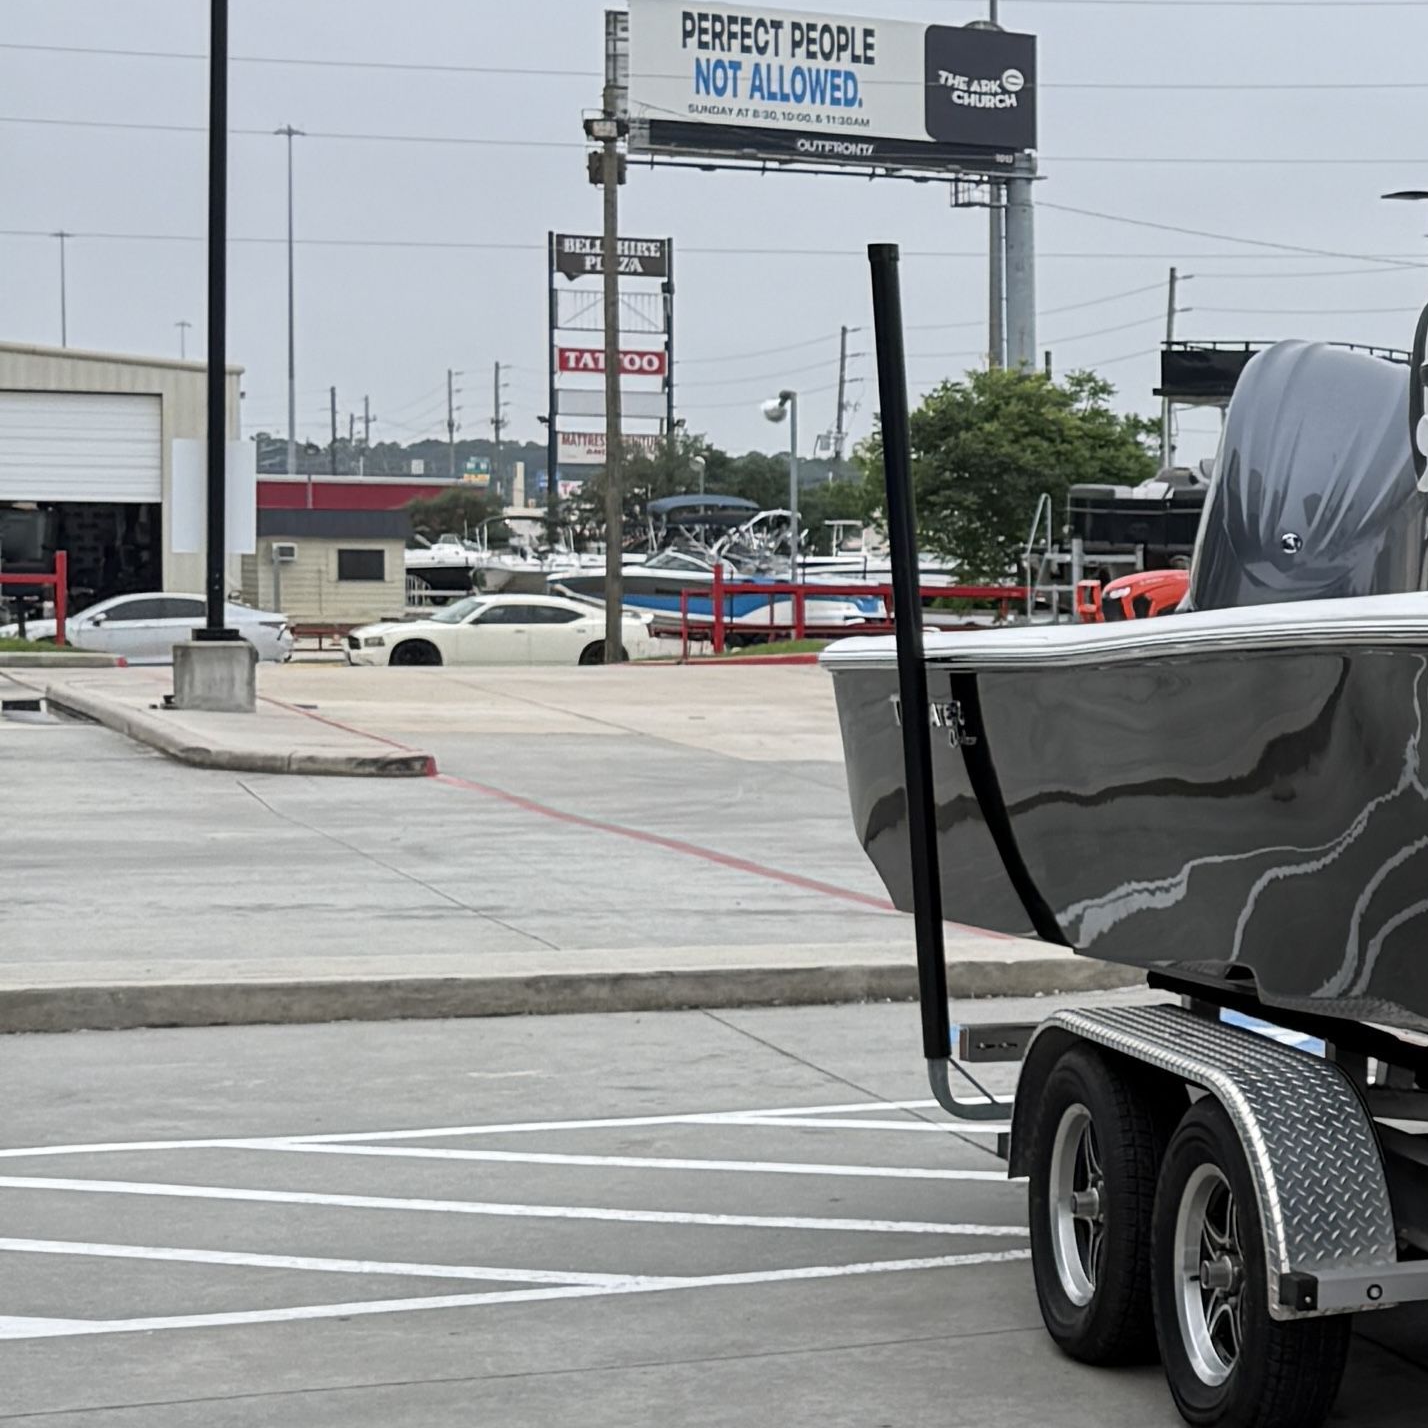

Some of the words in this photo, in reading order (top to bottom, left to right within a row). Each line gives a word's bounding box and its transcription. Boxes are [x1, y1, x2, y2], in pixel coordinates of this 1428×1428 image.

[682, 11, 784, 57] PERFECT
[791, 21, 876, 65] PEOPLE
[695, 57, 742, 98] NOT
[749, 62, 863, 108] ALLOWED.
[938, 70, 969, 90] THE
[970, 79, 1002, 93] ARK
[952, 90, 1018, 108] CHURCH
[688, 103, 733, 118] SUNDAY
[736, 107, 751, 118] AT
[564, 237, 661, 258] BELLHIRE
[585, 255, 644, 273] PLZA
[564, 351, 660, 372] TATOO
